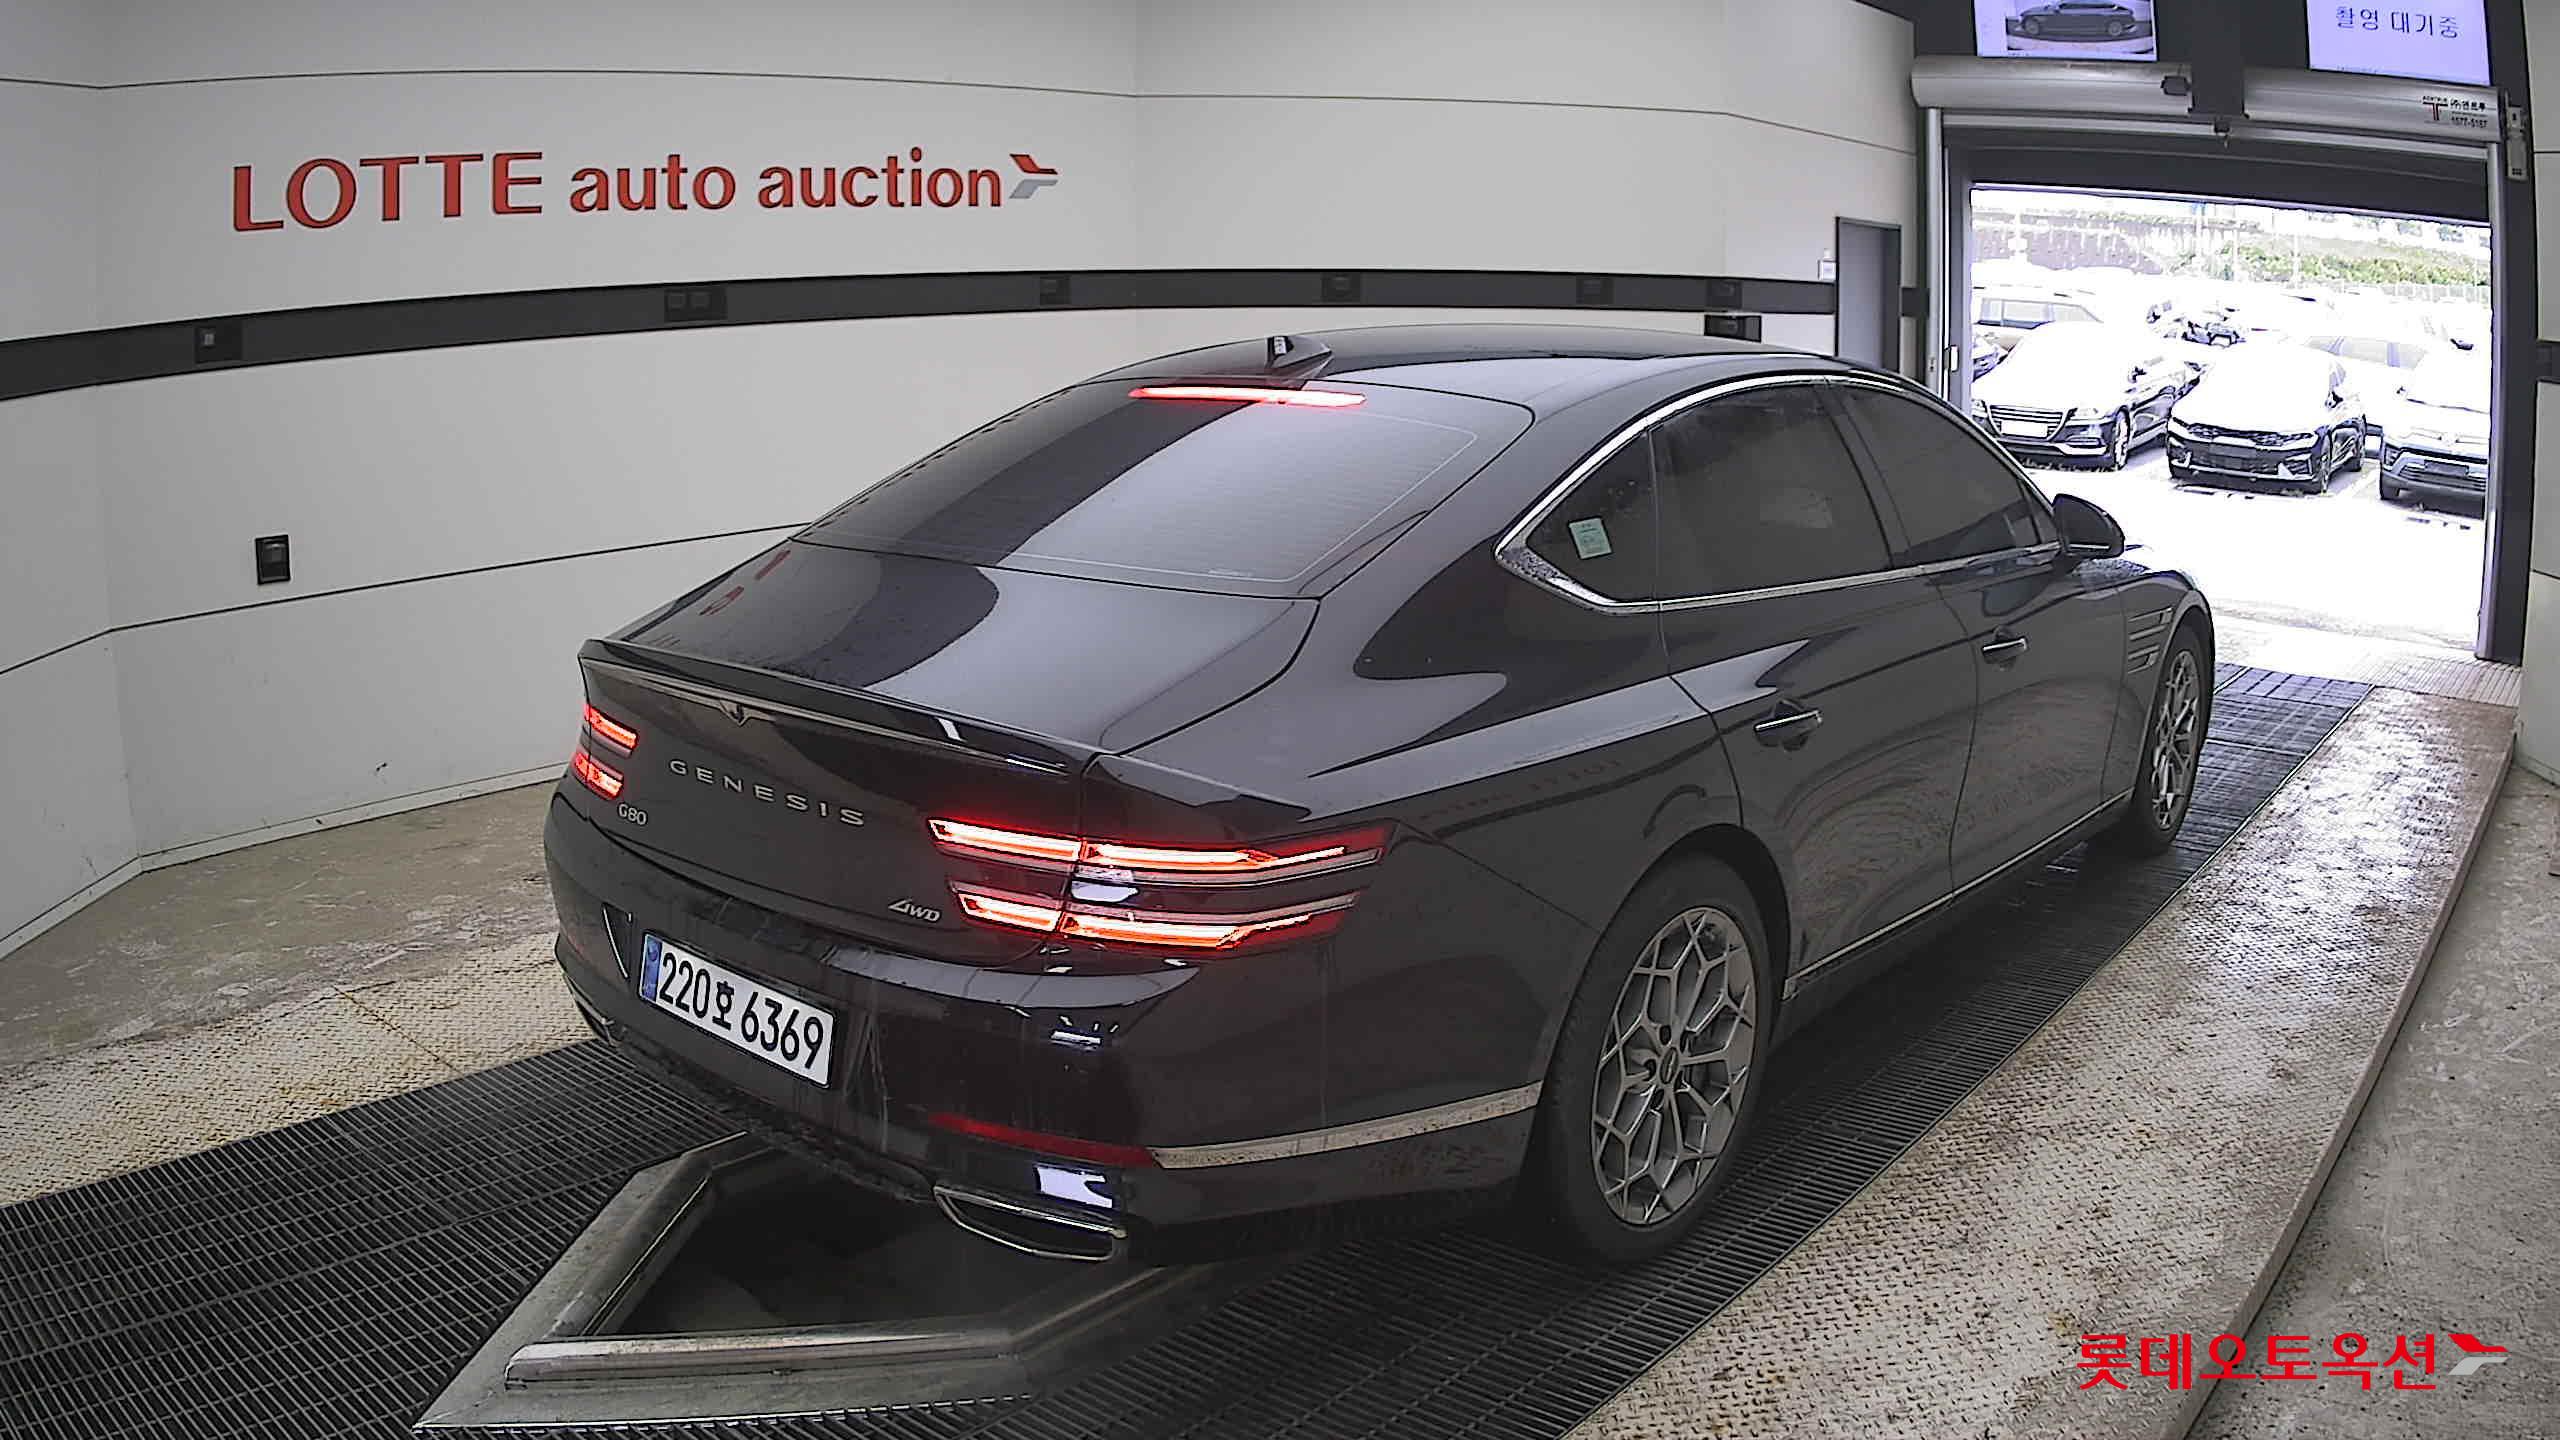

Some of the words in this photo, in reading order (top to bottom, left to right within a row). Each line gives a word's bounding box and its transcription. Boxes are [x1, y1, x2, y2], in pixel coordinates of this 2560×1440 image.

[2391, 12, 2459, 39] 대기중
[233, 151, 543, 233] LOTTE
[569, 153, 737, 213] auto
[758, 147, 1002, 210] auction
[617, 803, 648, 826] G80
[669, 760, 865, 827] GENESIS
